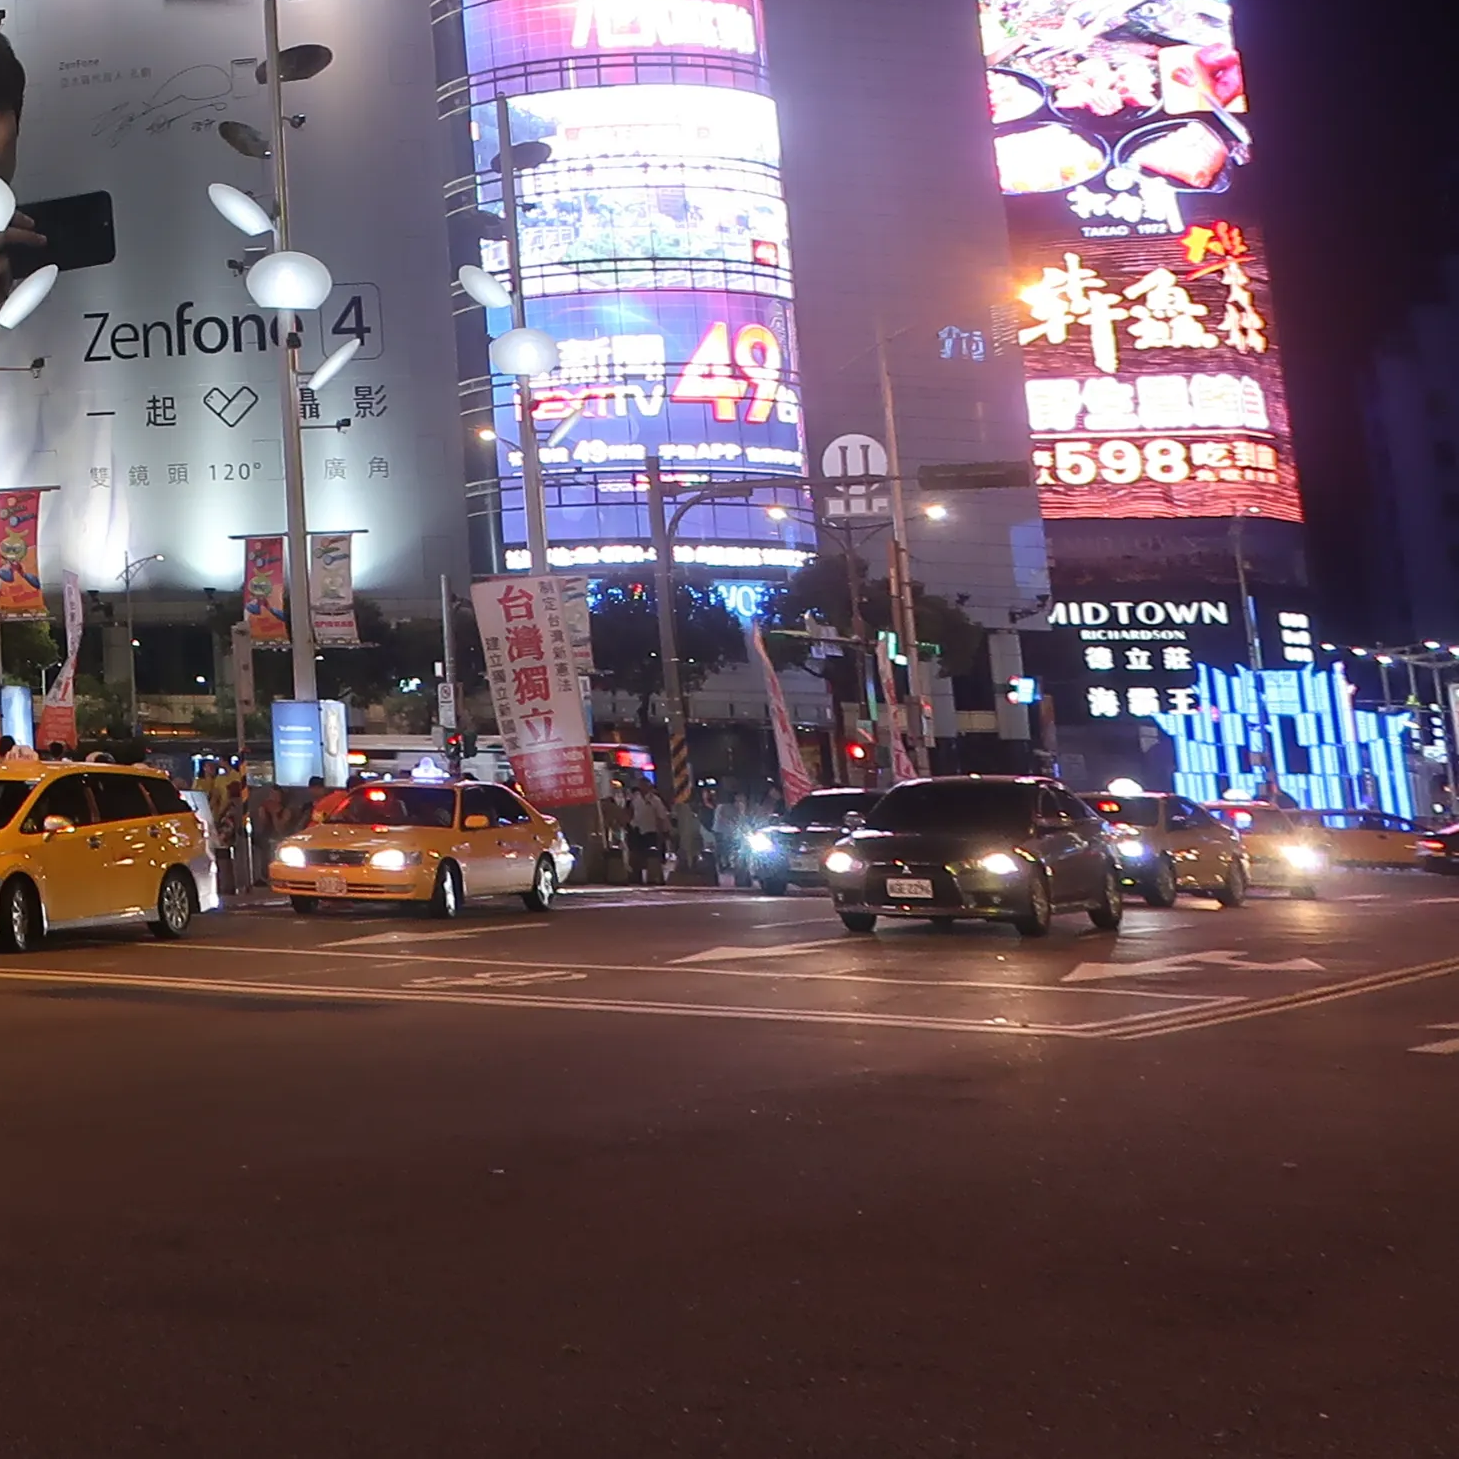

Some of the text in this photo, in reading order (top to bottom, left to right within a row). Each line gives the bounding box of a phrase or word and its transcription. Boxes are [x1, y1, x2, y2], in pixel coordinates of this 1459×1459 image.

[83, 301, 304, 363] Zenfone
[86, 391, 178, 429] 一起
[88, 461, 189, 490] 雙鏡頭
[207, 461, 263, 483] 120°
[322, 455, 391, 481] 廣角
[1054, 439, 1190, 485] 598
[1048, 600, 1230, 627] MIDTOWN
[1080, 628, 1187, 642] RICHARDSON
[496, 584, 564, 747] 台灣獨立
